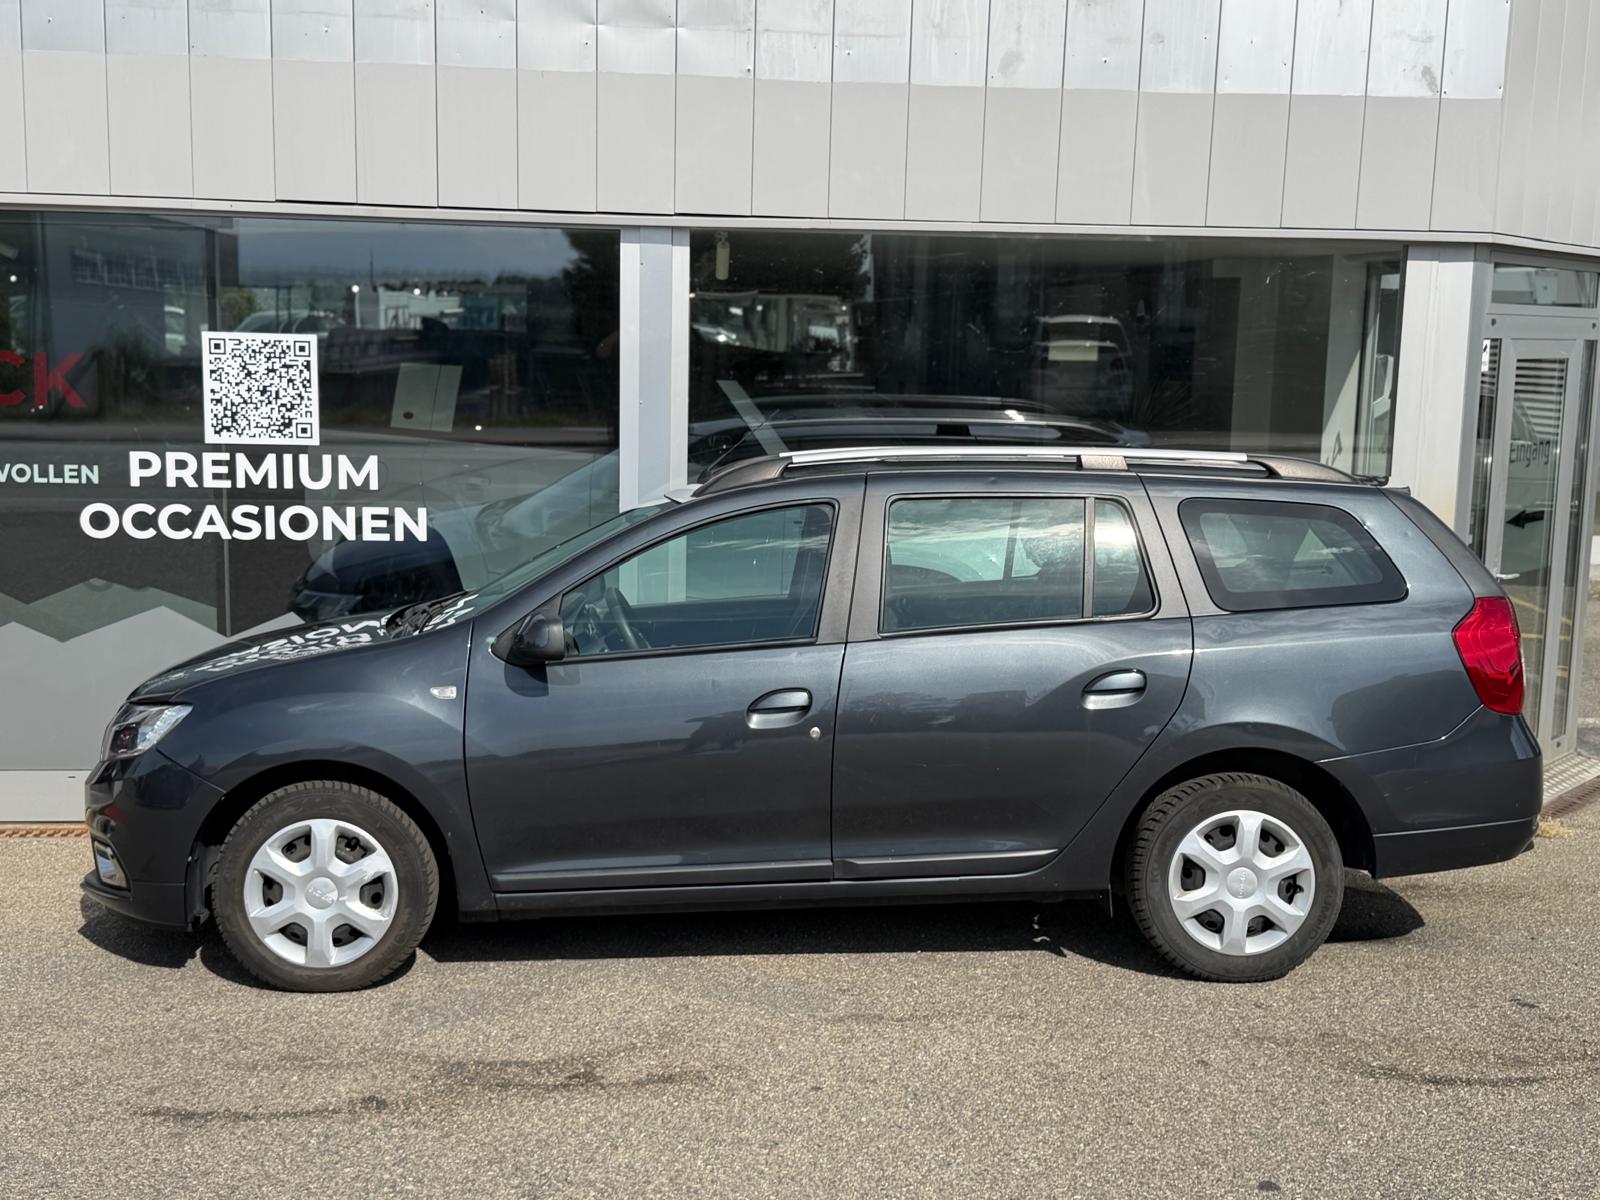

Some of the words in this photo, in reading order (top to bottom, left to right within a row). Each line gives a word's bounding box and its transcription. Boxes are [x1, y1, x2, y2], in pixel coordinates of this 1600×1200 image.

[129, 451, 379, 491] PREMIUM
[1510, 441, 1550, 468] Eingang
[79, 502, 428, 542] OCCASIONEN
